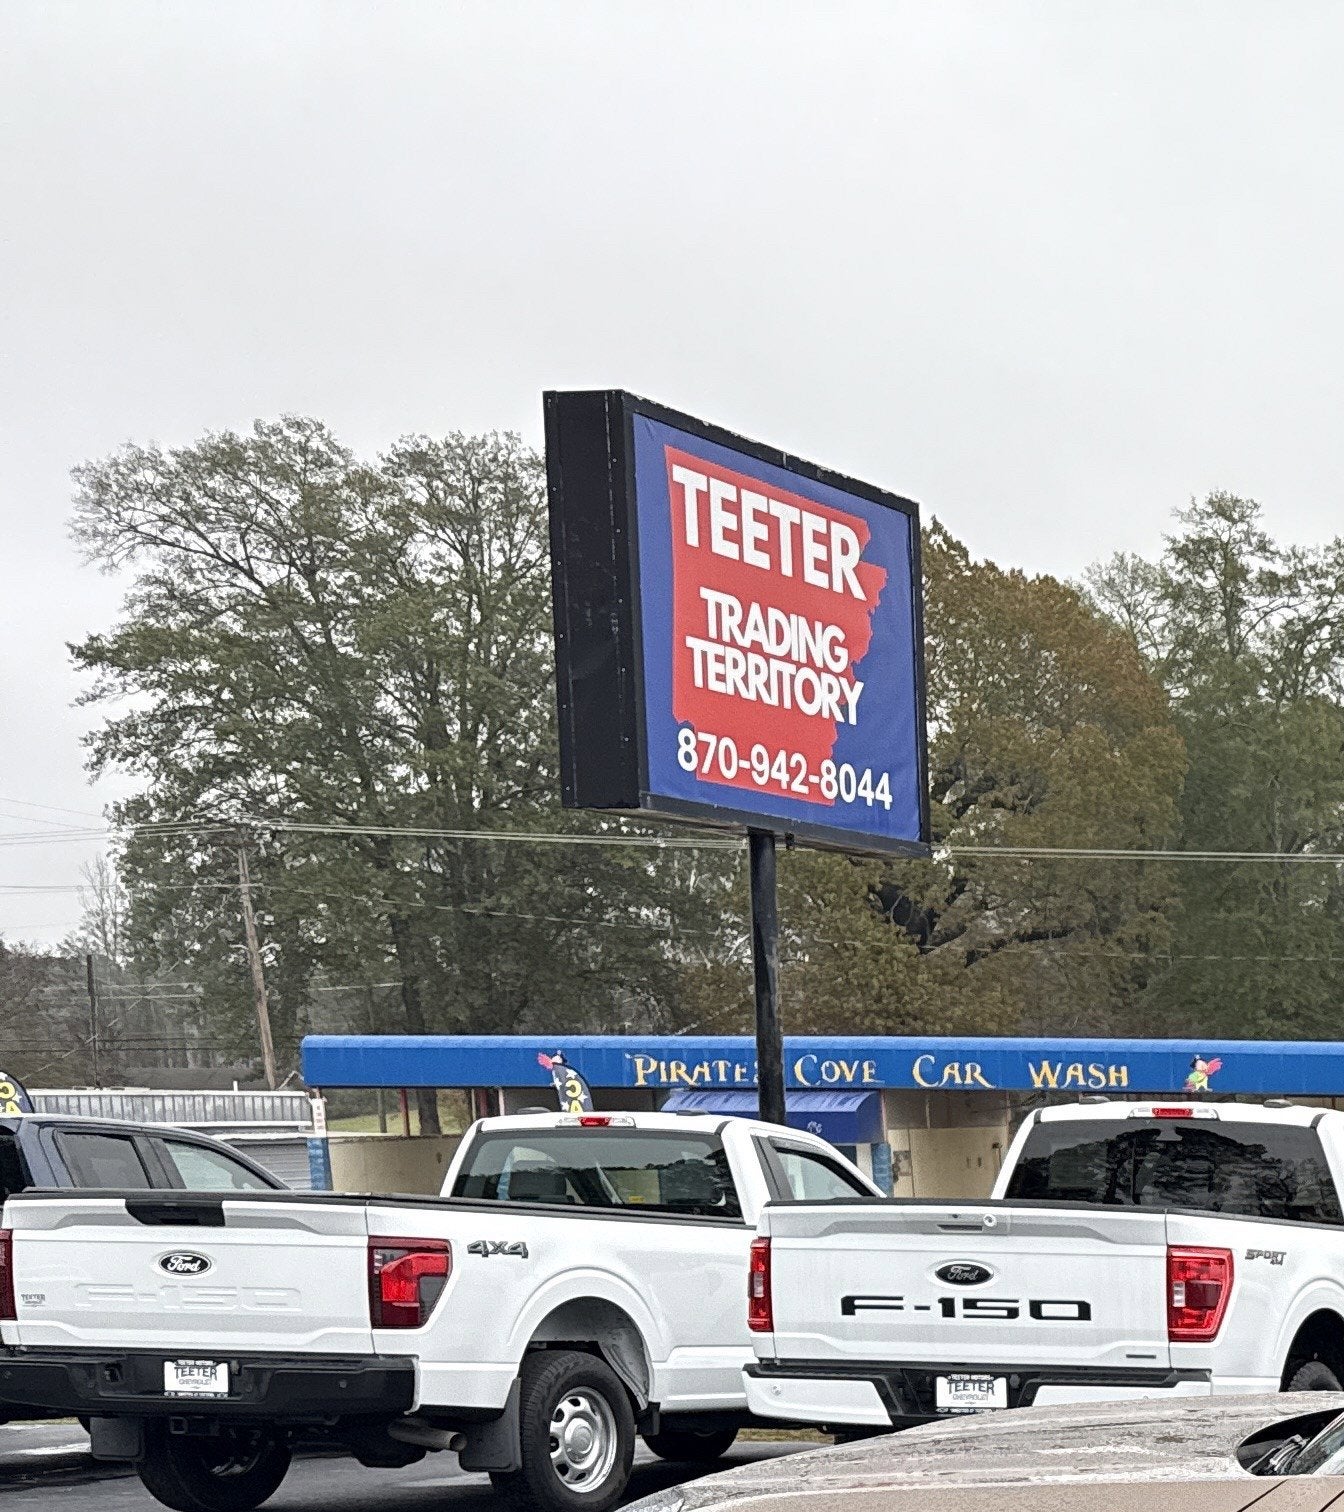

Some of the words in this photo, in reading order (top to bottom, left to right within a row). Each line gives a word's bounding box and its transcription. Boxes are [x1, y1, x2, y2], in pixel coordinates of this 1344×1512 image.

[672, 464, 867, 600] TEETER
[700, 586, 848, 673] TRADING
[686, 636, 864, 725] TERRITORY
[677, 728, 893, 810] 870-942-8044
[794, 1054, 885, 1087] COVE
[912, 1054, 996, 1088] CAR
[1028, 1060, 1128, 1089] WASH
[167, 1255, 202, 1272] Ford
[841, 1295, 1092, 1321] F-150
[174, 1366, 217, 1380] TEETER
[947, 1381, 995, 1396] TEETER
